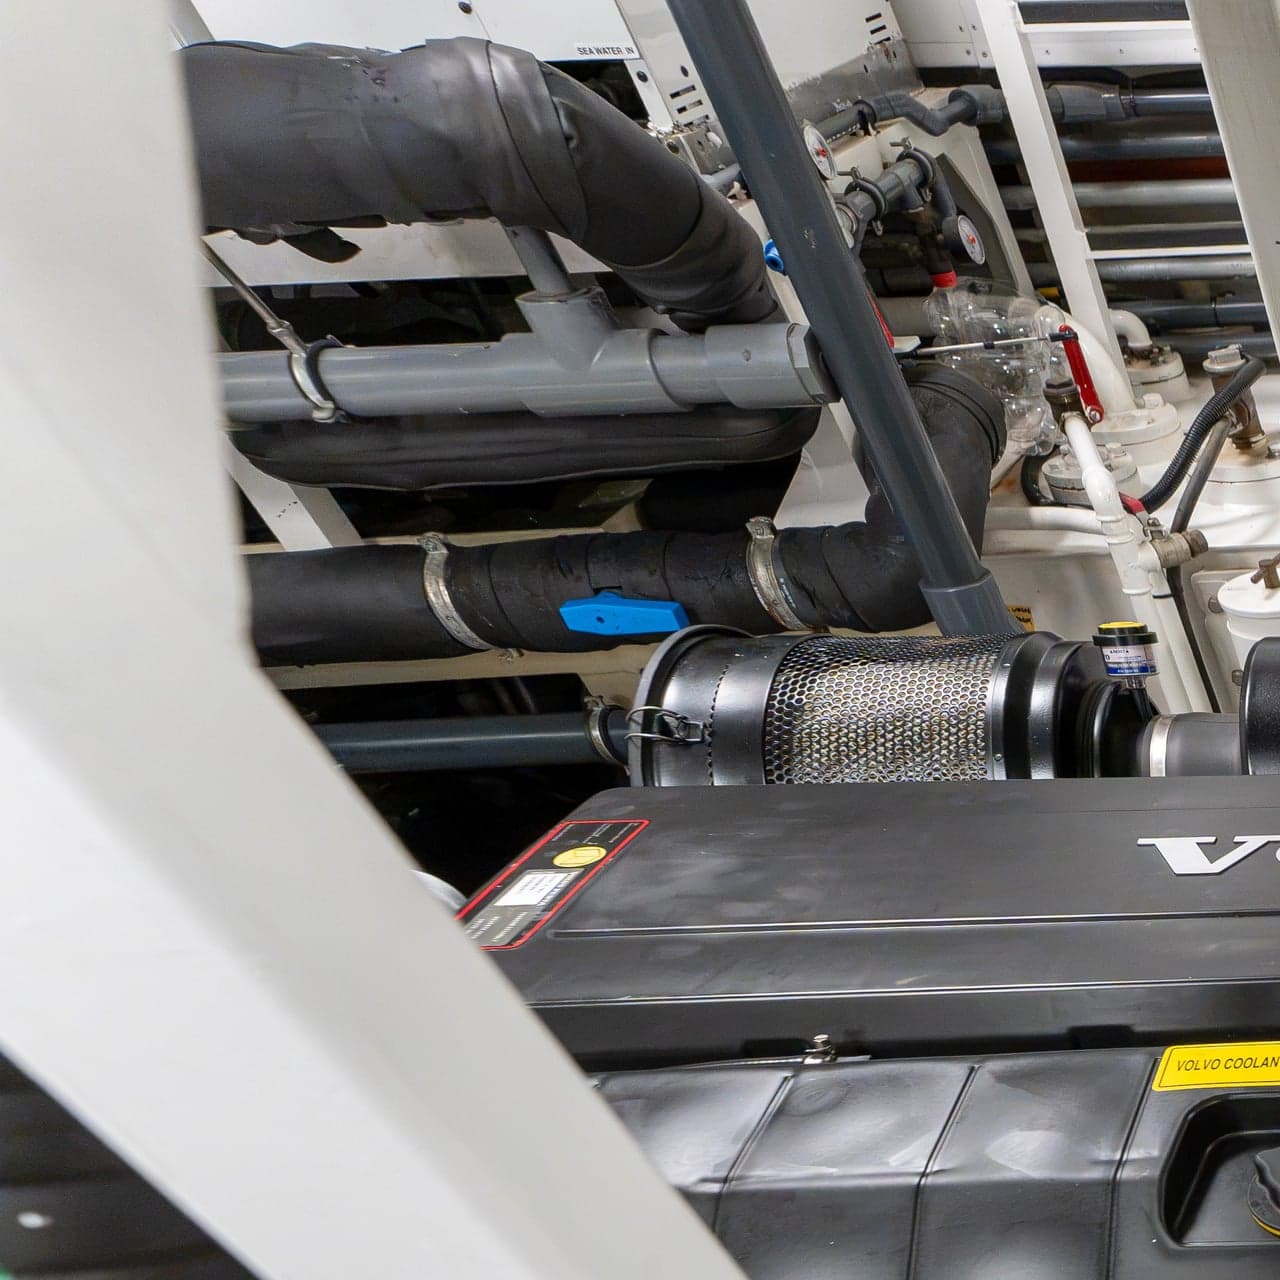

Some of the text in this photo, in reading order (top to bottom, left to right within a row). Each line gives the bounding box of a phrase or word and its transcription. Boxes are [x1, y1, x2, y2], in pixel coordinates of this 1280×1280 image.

[577, 46, 594, 56] SEA
[594, 46, 623, 56] WATER
[1177, 1058, 1222, 1072] VOLVO
